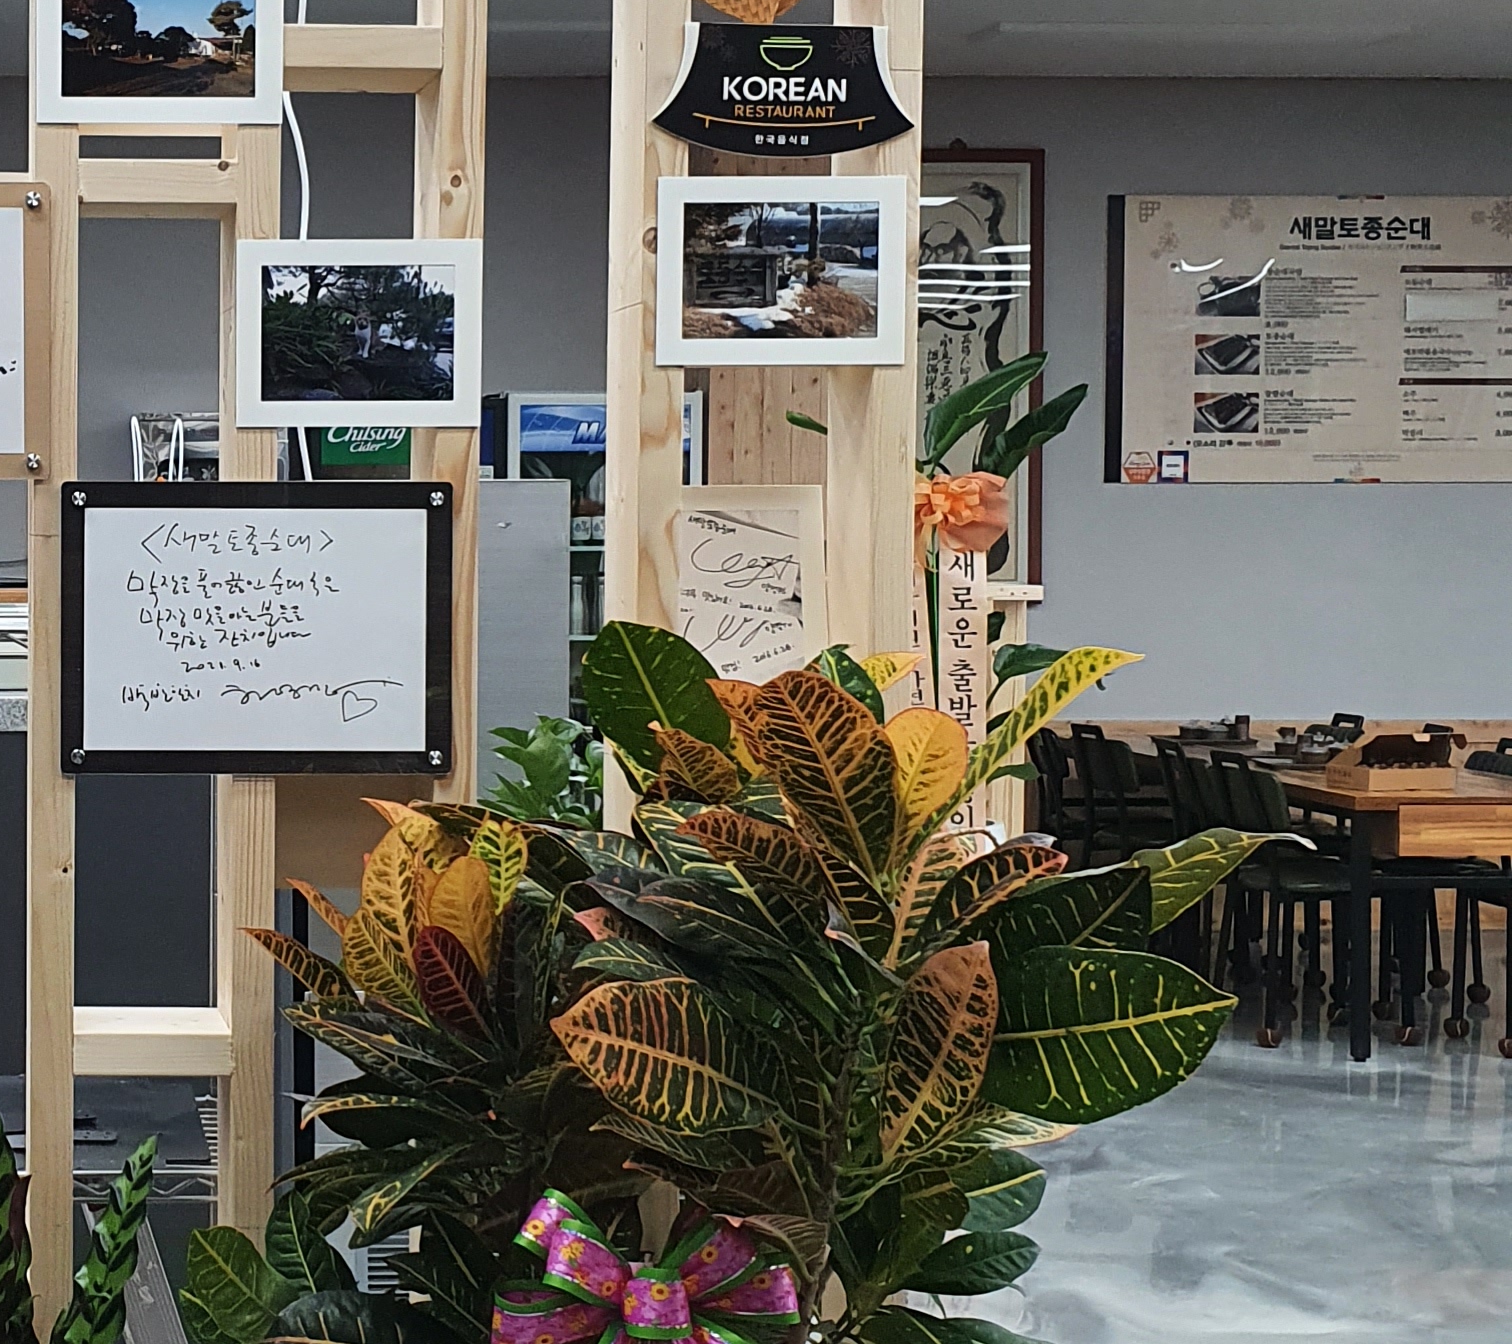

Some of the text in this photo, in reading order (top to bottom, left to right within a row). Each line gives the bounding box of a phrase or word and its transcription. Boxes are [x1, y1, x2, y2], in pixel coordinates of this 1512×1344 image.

[722, 76, 848, 102] KOREAN
[734, 104, 836, 119] RESTAURANT
[754, 134, 810, 146] 한국음식점
[1289, 215, 1431, 241] 새말토종순대
[349, 440, 387, 453] Cider
[948, 550, 978, 649] 새로운
